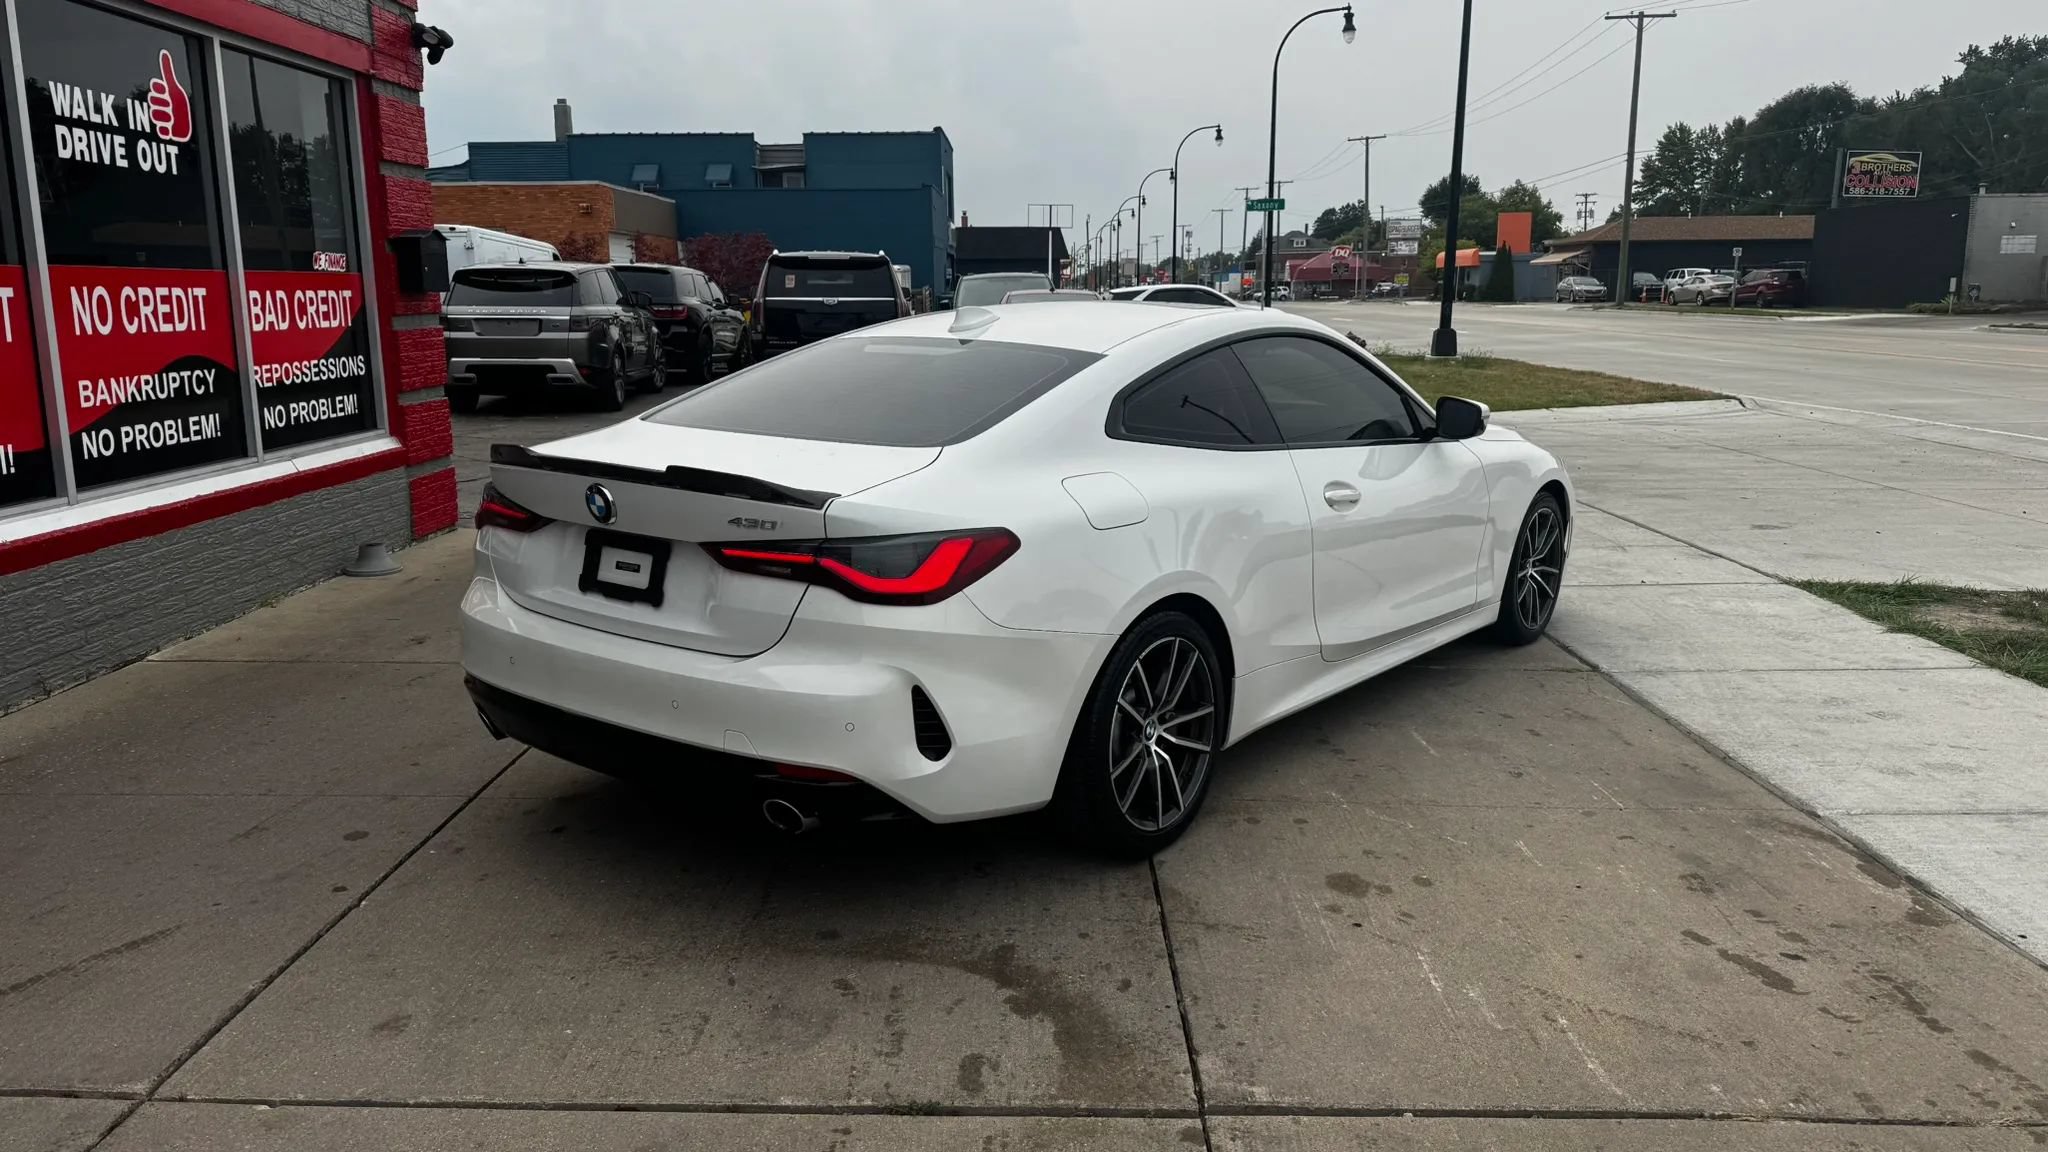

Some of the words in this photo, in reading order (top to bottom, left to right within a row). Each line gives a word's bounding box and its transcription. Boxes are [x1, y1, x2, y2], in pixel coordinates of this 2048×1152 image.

[48, 80, 119, 127] WALK
[126, 98, 151, 133] IN
[55, 124, 129, 168] DRIVE
[137, 139, 179, 175] OUT
[1861, 163, 1912, 172] BROTHERS
[1846, 174, 1917, 188] COLLISION
[1849, 187, 1911, 195] 586-218-7557
[1334, 248, 1350, 257] DQ
[70, 286, 113, 336] NO
[120, 286, 207, 334] CREDIT
[249, 290, 290, 332] BAD
[294, 289, 352, 330] CREDIT
[78, 368, 216, 408] BANKRUPTCY
[253, 355, 366, 388] REPOSSESSIONS
[263, 405, 286, 430] NO
[289, 393, 359, 425] PROBLEM!
[81, 428, 115, 459] NO
[120, 413, 222, 453] PROBLEM!
